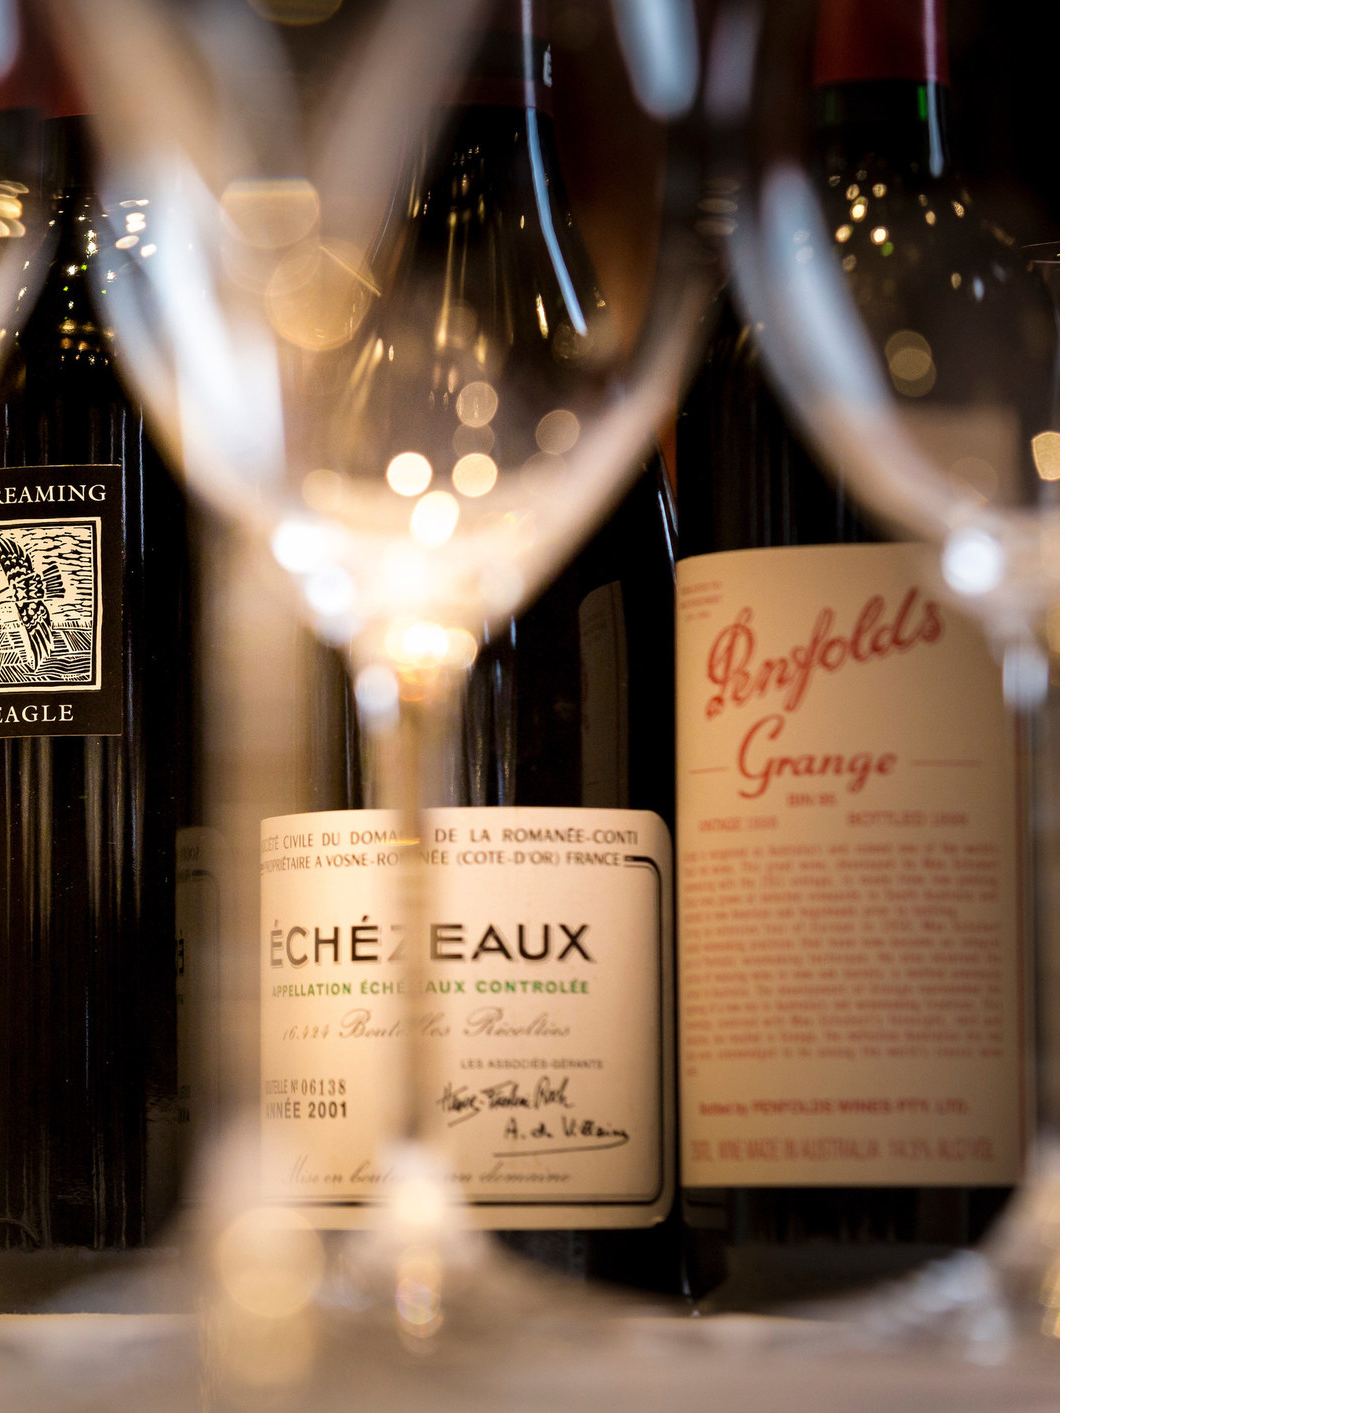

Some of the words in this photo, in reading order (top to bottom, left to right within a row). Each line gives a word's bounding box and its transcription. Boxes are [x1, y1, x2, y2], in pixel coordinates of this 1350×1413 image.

[706, 585, 945, 721] Penfolds
[737, 713, 898, 799] Grange
[283, 833, 314, 850] CIVILE
[322, 832, 340, 847] DU
[350, 829, 415, 846] DOMA
[434, 828, 458, 843] DE
[469, 828, 492, 843] LA
[501, 827, 639, 846] ROMANÉE-CONTI
[325, 849, 451, 868] VOSNE-RONÉE
[565, 851, 621, 868] FRANCE
[272, 981, 352, 999] APPELLATION
[360, 978, 466, 996] ÉCHÉAUX
[338, 1006, 451, 1041] Boutlles
[460, 1057, 483, 1070] LES
[307, 1100, 348, 1119] 2001
[839, 1097, 891, 1114] WINES
